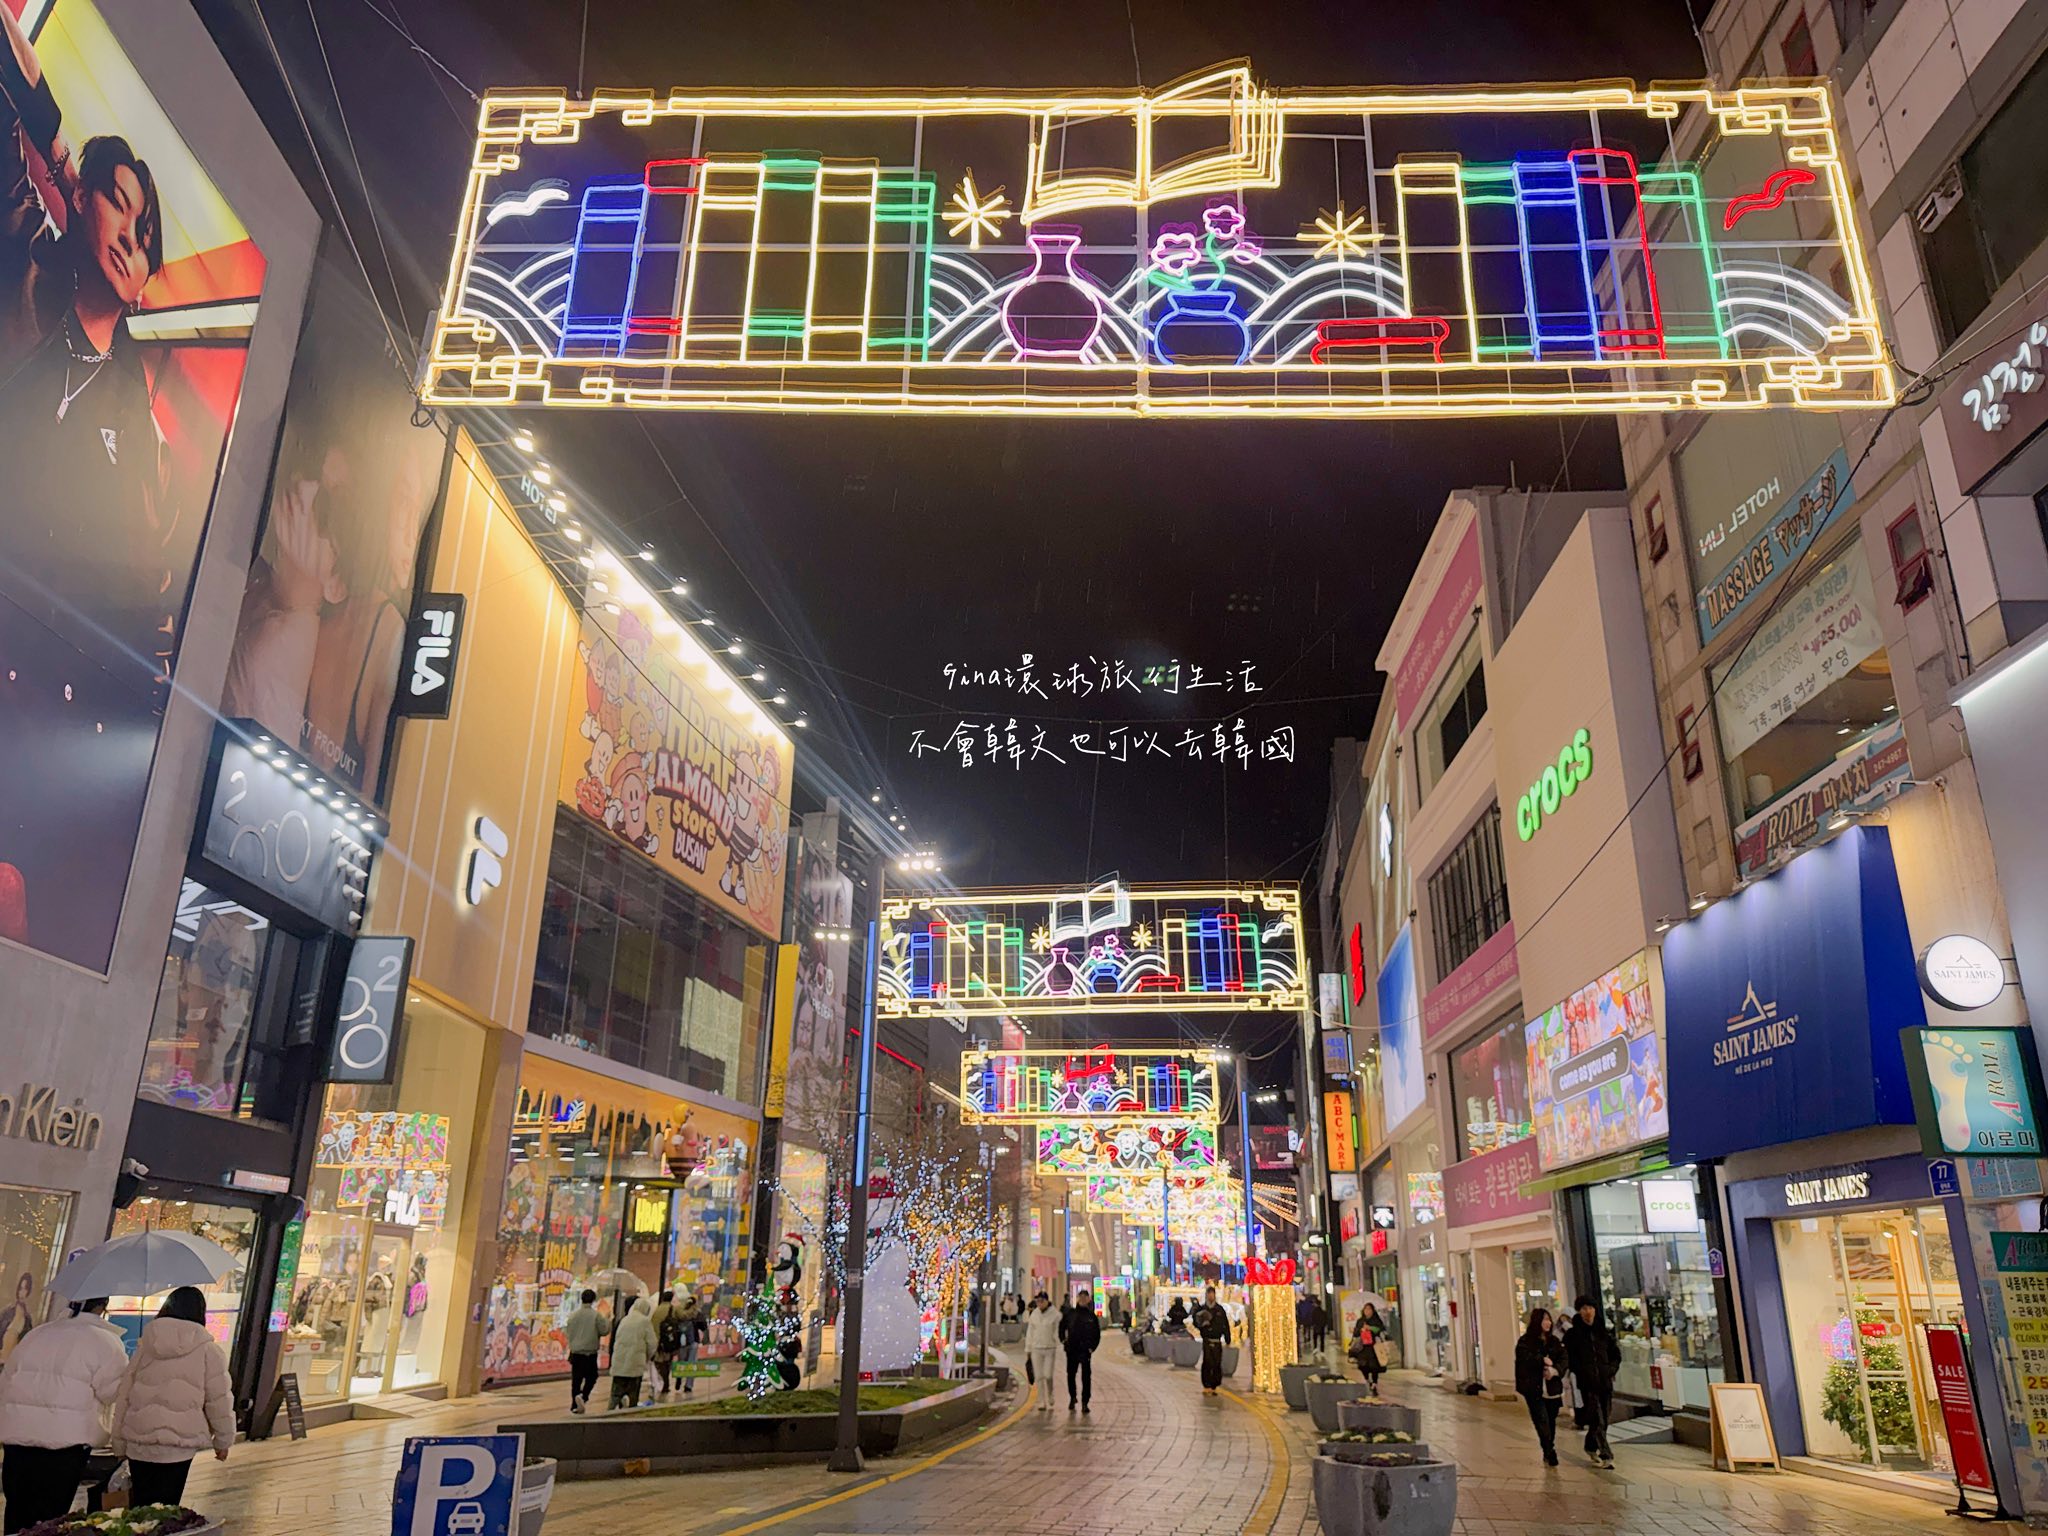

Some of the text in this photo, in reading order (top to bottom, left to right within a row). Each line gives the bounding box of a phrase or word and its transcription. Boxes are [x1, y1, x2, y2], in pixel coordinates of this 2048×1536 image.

[1707, 536, 1775, 630] MASSAGE
[1776, 464, 1837, 556] マッサージ
[411, 610, 455, 696] FILA
[314, 730, 358, 777] PRODUKT
[655, 751, 736, 843] ALMOND
[1517, 728, 1592, 842] crocs
[672, 798, 717, 847] store
[674, 828, 708, 873] BUSAN
[1934, 970, 1997, 980] SAINT JAMES
[1713, 1032, 1750, 1067] SAINT
[20, 1083, 104, 1151] Klein
[1978, 1130, 2036, 1150] 아로마
[1937, 1165, 1948, 1180] 77
[384, 1190, 420, 1226] FILA
[1650, 1201, 1692, 1211] crocs
[1785, 1180, 1821, 1207] SAINT
[635, 1198, 668, 1235] HBAF
[544, 1241, 576, 1271] HBAF
[2013, 1321, 2035, 1332] OPEN
[2015, 1333, 2038, 1344] CLOSE
[1937, 1364, 1966, 1379] SALE
[410, 1444, 497, 1536] P
